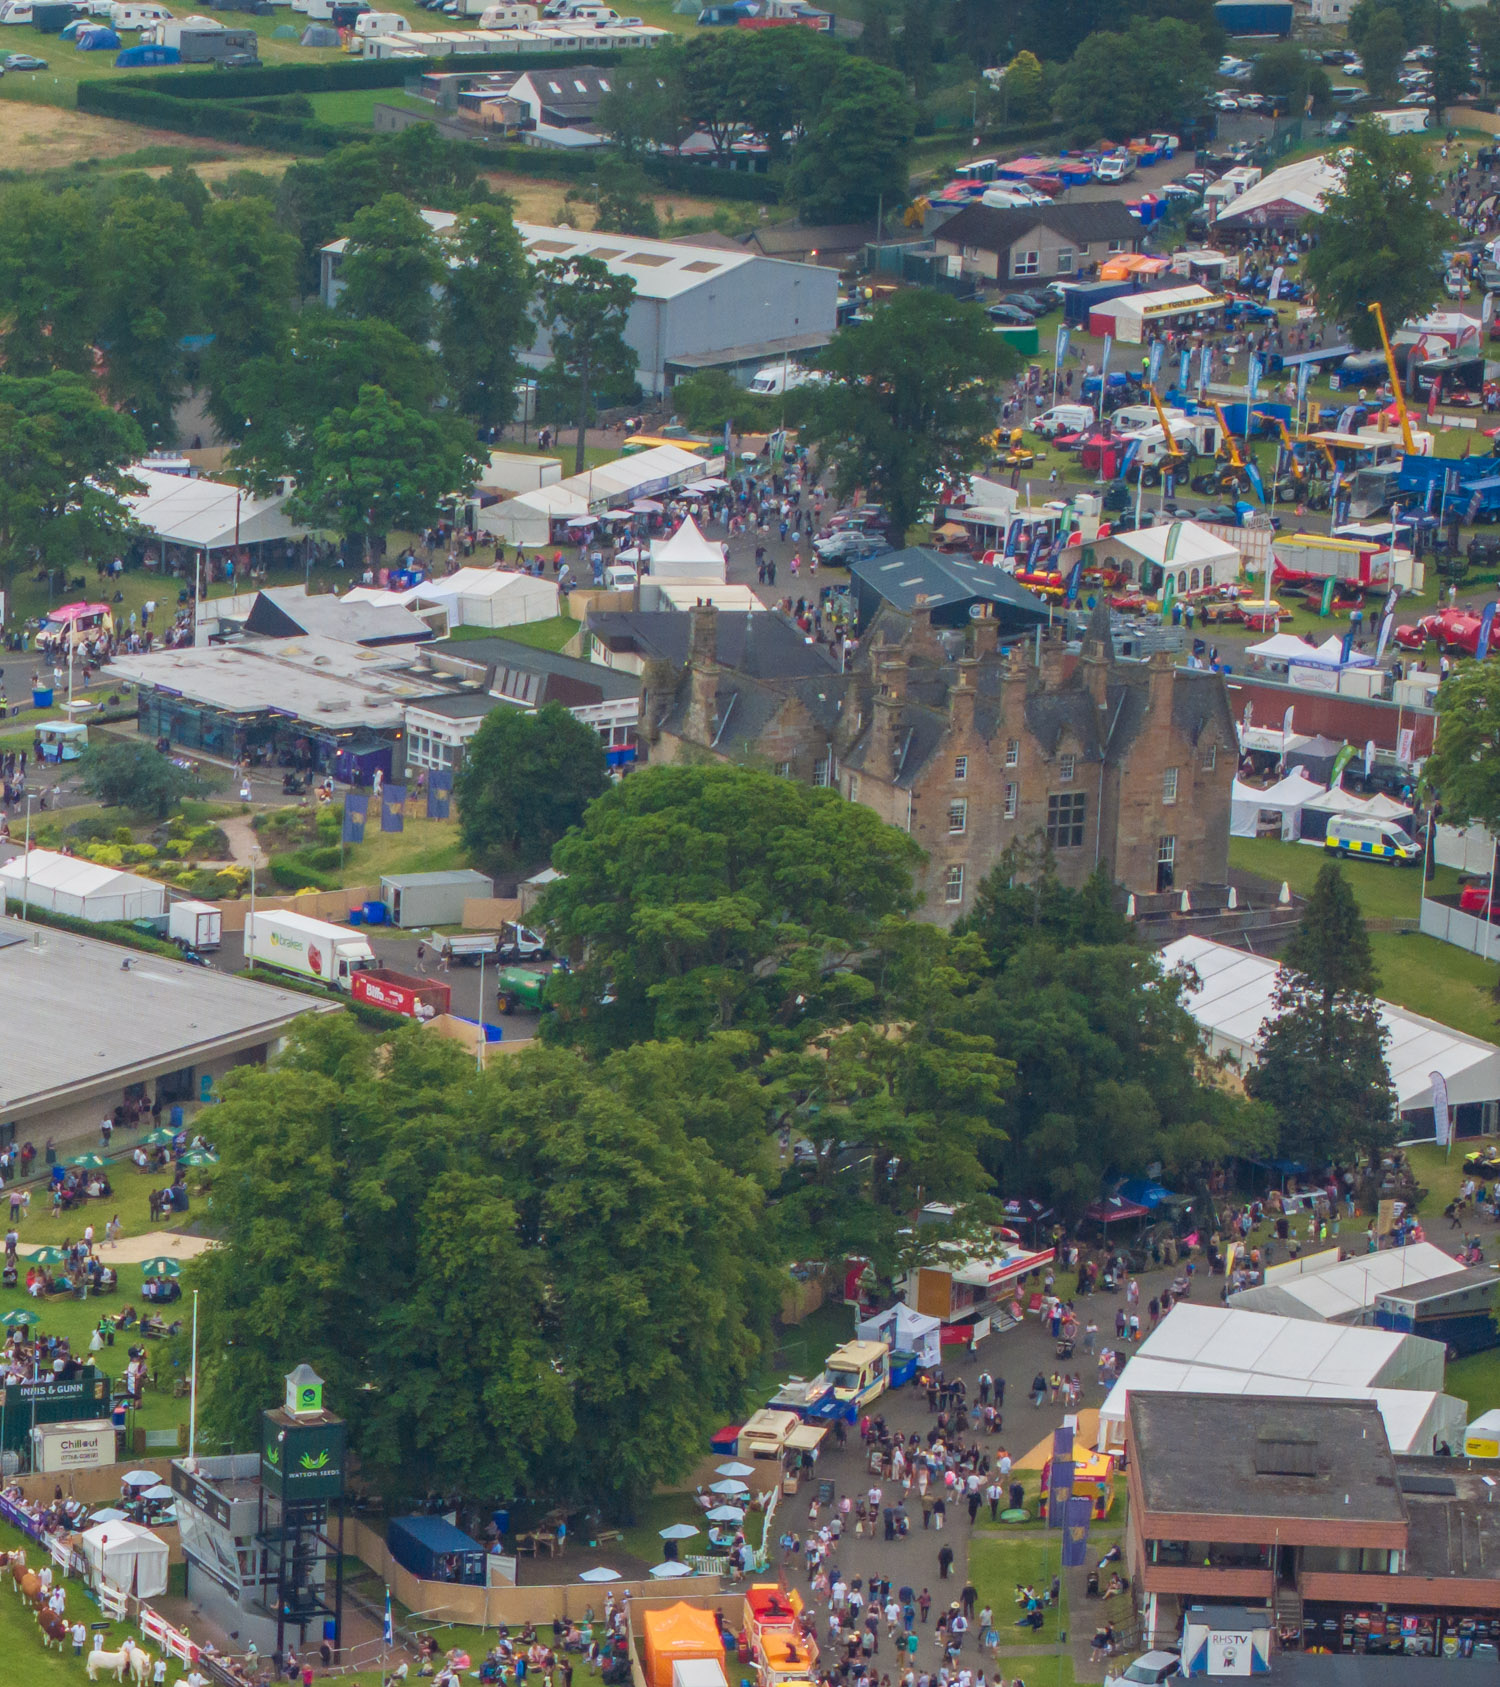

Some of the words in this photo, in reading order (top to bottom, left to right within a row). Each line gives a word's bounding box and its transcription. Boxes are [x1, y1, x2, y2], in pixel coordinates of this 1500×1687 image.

[20, 1386, 44, 1396] INNIS
[48, 1385, 55, 1394] &
[57, 1383, 83, 1393] GUNN
[60, 1437, 98, 1450] Chillout
[289, 1471, 317, 1479] WATSON
[320, 1469, 340, 1477] SEEDS
